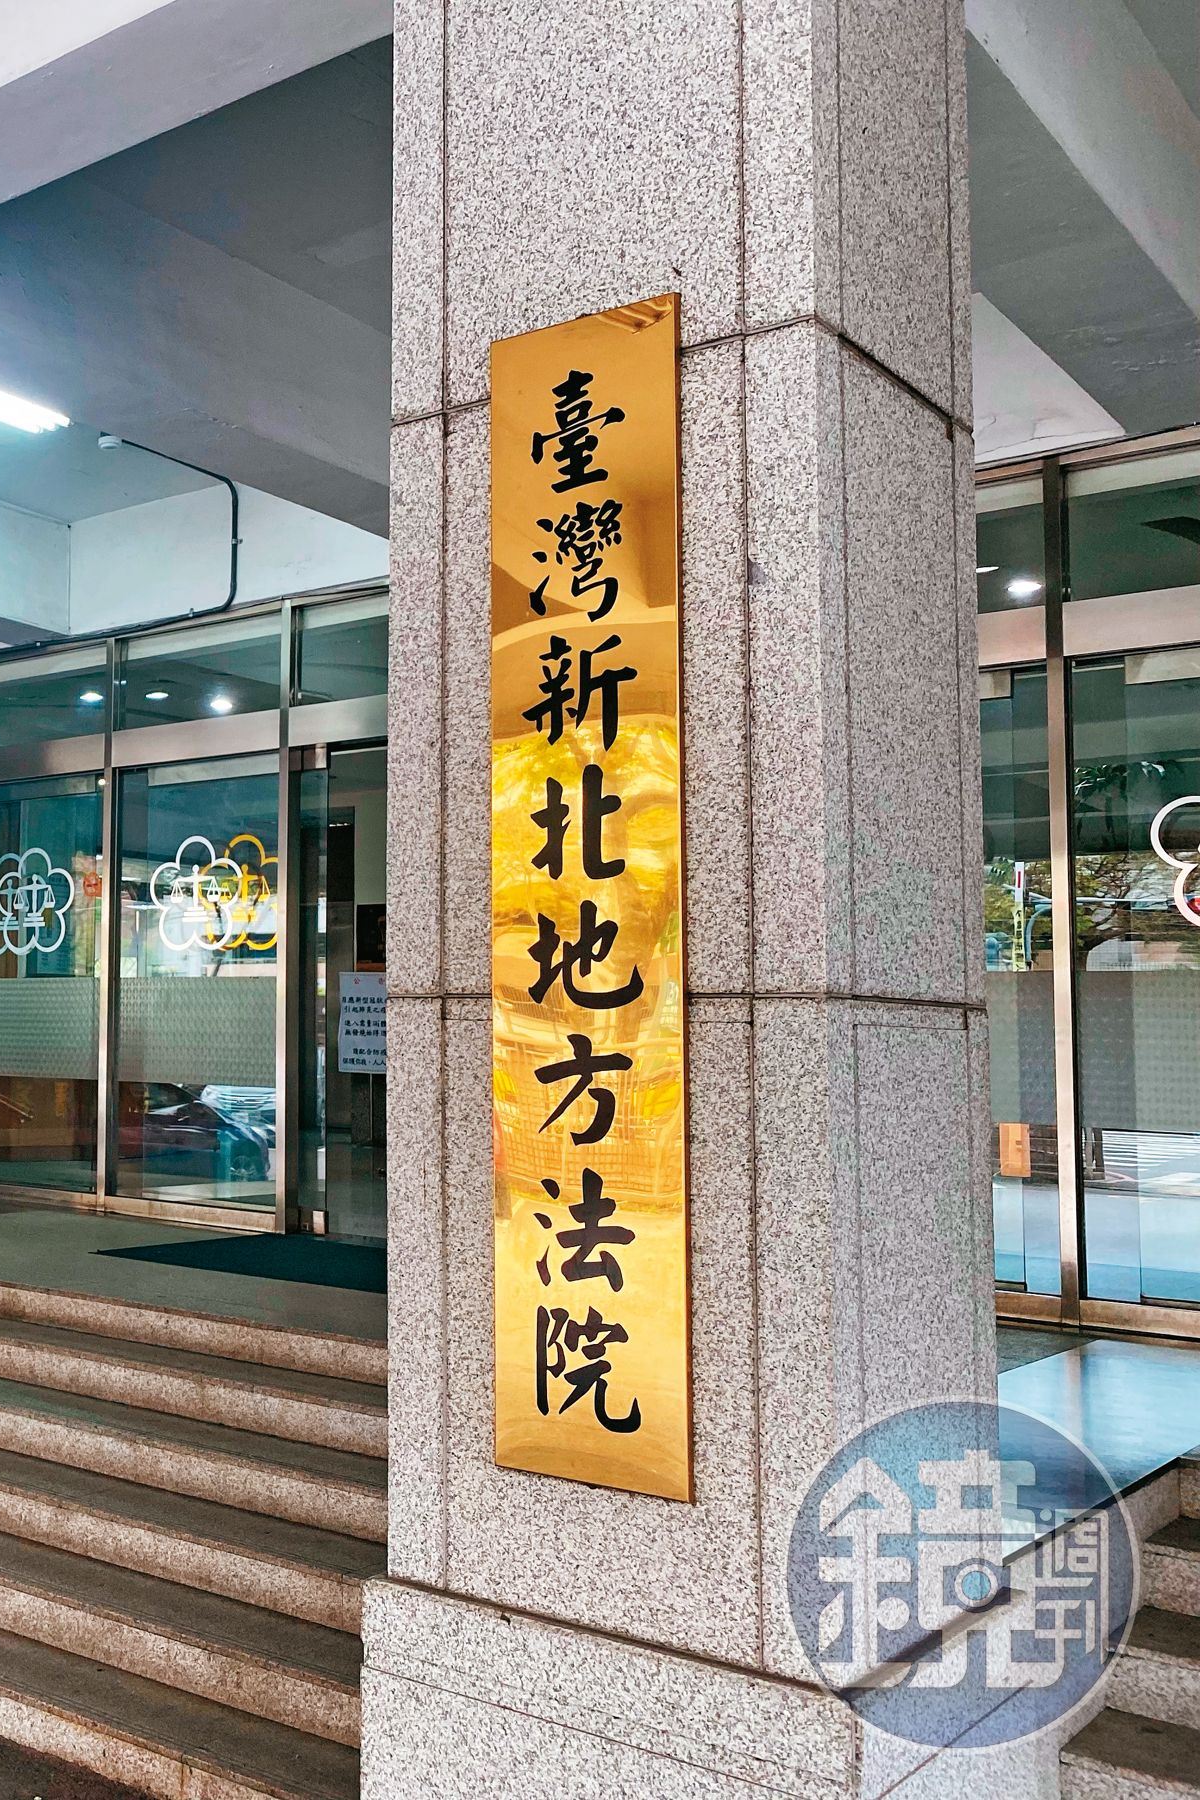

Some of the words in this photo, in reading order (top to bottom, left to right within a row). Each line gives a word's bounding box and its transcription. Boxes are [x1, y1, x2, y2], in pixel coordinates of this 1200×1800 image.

[521, 369, 645, 1434] 臺灣新北地方法院
